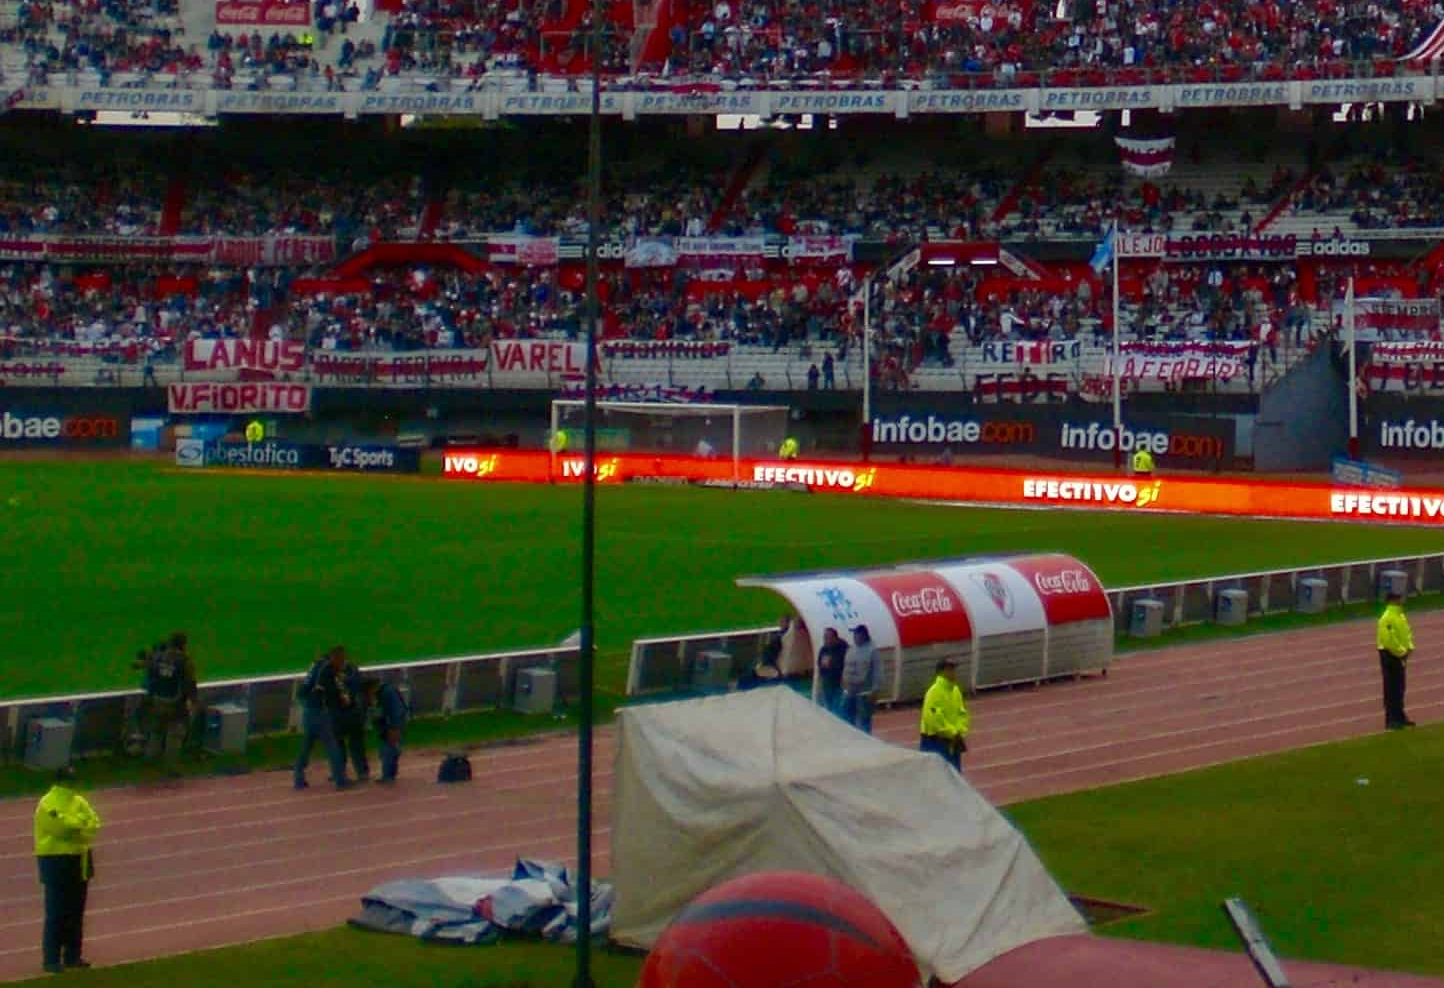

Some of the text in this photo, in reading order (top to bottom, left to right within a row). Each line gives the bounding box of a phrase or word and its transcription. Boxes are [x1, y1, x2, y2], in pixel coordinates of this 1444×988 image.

[1181, 85, 1288, 103] PETROBRAS
[1311, 81, 1415, 98] PETROBRAS
[80, 91, 194, 106] PETROBRAS
[223, 93, 338, 109] PETROBRAS
[365, 93, 474, 109] PETROBRAS
[779, 94, 885, 108] PETROBRAS
[916, 92, 1022, 108] PETROBRAS
[1046, 90, 1152, 106] PETROBRAS
[1313, 238, 1370, 255] adidas
[183, 339, 304, 372] LANUS
[982, 342, 1081, 363] RETIRO
[328, 447, 394, 467] TyC Sports
